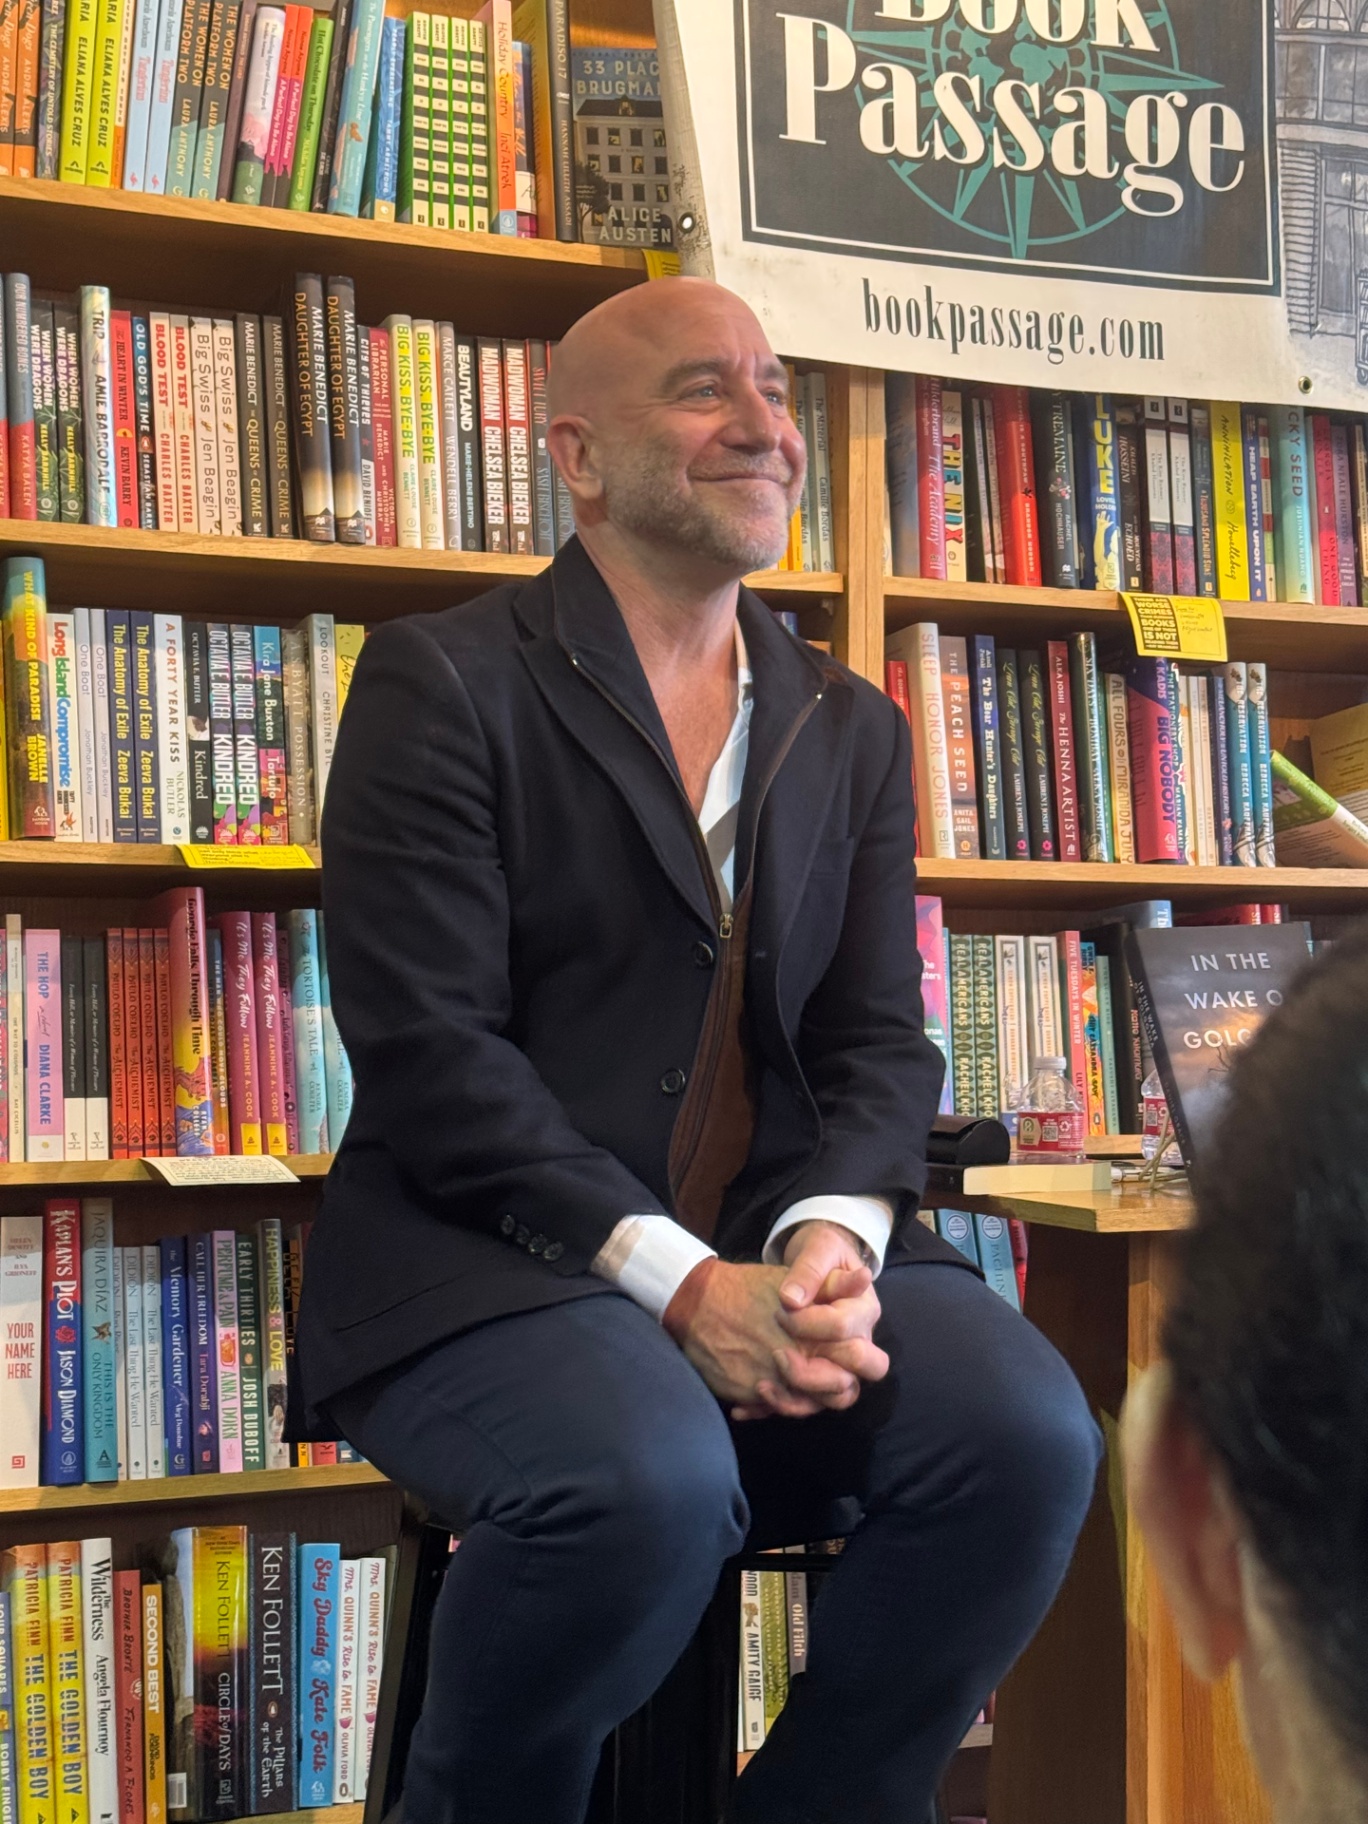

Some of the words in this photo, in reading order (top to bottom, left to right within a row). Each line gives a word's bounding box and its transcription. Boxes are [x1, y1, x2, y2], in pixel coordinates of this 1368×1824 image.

[180, 0, 195, 54] PLATFORM
[199, 2, 209, 21] THE
[103, 38, 114, 81] ELIANA
[194, 25, 208, 67] WOMEN
[497, 21, 508, 66] Holiday
[177, 59, 189, 83] TWO
[192, 70, 202, 86] ON
[311, 45, 324, 91] Chocolate
[583, 61, 605, 74] 33
[614, 62, 659, 76] PLAC
[100, 82, 111, 115] ALVES
[497, 68, 507, 119] Country
[181, 99, 192, 127] LAURA
[304, 99, 316, 133] Thursday
[775, 12, 1245, 217] Passage
[98, 118, 109, 147] CRUZ
[176, 129, 188, 177] ANTHONY
[607, 207, 662, 221] ALICE
[600, 227, 671, 243] AUSTEN
[31, 325, 41, 354] WERE
[92, 310, 105, 339] TRIP
[135, 324, 145, 350] OLD
[295, 292, 311, 369] DAUGHTER
[311, 307, 323, 351] MARIE
[397, 325, 409, 352] BIG
[862, 277, 1165, 365] bookpassage.com
[42, 330, 52, 360] WHEN
[116, 341, 125, 372] HEART
[155, 324, 166, 368] BLOOD
[195, 335, 210, 361] Big
[32, 357, 42, 410] DRAGONS
[42, 364, 53, 406] WOMEN
[95, 375, 106, 410] AMIE
[118, 375, 126, 384] IN
[137, 355, 146, 396] GOD'S
[157, 372, 168, 407] TEST
[198, 366, 211, 413] Swiss
[299, 372, 311, 389] OF
[313, 353, 327, 423] BENEDICT
[458, 345, 472, 431] BEAUTYLAND
[482, 348, 501, 421] MADWOMAN
[118, 386, 128, 420] WINTER
[139, 401, 150, 432] TIME
[300, 393, 313, 436] EGYPT
[401, 397, 415, 458] BYE-BYE
[1094, 394, 1114, 494] LUKE
[160, 433, 171, 479] CHARLES
[201, 437, 212, 462] Jen
[485, 426, 502, 482] CHELSEA
[942, 434, 961, 485] THE
[162, 482, 173, 523] BAXTER
[201, 467, 215, 519] Beagin
[487, 486, 504, 524] BIEKER
[1251, 481, 1259, 526] EARTH
[943, 493, 963, 544] NIX
[1252, 528, 1261, 564] UPON
[23, 571, 34, 605] WHAT
[1253, 566, 1262, 581] IT
[24, 607, 36, 642] KIND
[112, 624, 125, 645] The
[166, 623, 175, 632] A
[1140, 619, 1175, 628] BOOKS
[1144, 632, 1154, 640] IS
[1156, 633, 1177, 641] NOT
[27, 645, 37, 659] OF
[166, 637, 177, 683] FORTY
[210, 631, 228, 671] OCTAVIA
[262, 642, 274, 666] Kira
[111, 646, 127, 697] Anatomy
[261, 668, 275, 695] Jane
[28, 661, 40, 721] PARADISE
[117, 698, 129, 712] of
[168, 688, 178, 724] YEAR
[211, 682, 231, 719] BUTLER
[1112, 680, 1123, 703] ALL
[117, 710, 130, 740] Exile
[265, 699, 277, 741] Buxton
[950, 681, 964, 739] PEACH
[1113, 706, 1126, 749] FOURS
[169, 732, 180, 762] KISS
[1156, 717, 1170, 748] BIG
[28, 736, 38, 782] BROWN
[36, 734, 48, 783] JANELLE
[117, 750, 130, 783] Zeeva
[213, 733, 234, 804] KINDRED
[1058, 728, 1070, 782] HENNA
[262, 756, 281, 798] Tartufo
[1158, 752, 1174, 823] NOBODY
[119, 786, 132, 819] Bukai
[1061, 787, 1076, 840] ARTIST
[37, 952, 48, 972] THE
[978, 942, 986, 968] REAL
[1068, 940, 1076, 956] FIVE
[1191, 954, 1219, 971] IN
[1226, 952, 1271, 969] THE
[38, 976, 49, 998] HOP
[1070, 959, 1078, 999] TUESDAYS
[979, 971, 990, 1026] AMERICANS
[1072, 1002, 1078, 1012] IN
[1185, 990, 1257, 1009] WAKE
[1072, 1014, 1081, 1045] WINTER
[39, 1045, 51, 1078] DIANA
[39, 1082, 51, 1124] CLARKE
[239, 1243, 252, 1280] EARLY
[265, 1228, 282, 1313] HAPPINESS
[7, 1323, 33, 1339] YOUR
[240, 1289, 255, 1345] THIRTIES
[270, 1315, 281, 1328] &
[5, 1343, 35, 1358] NAME
[268, 1331, 284, 1371] LOVE
[7, 1363, 32, 1379] HERE
[243, 1377, 257, 1414] JOSH
[58, 1390, 74, 1443] DIAMOND
[244, 1415, 258, 1463] DUBOFF
[216, 1560, 230, 1591] KEN
[262, 1546, 282, 1591] KEN
[313, 1558, 333, 1592] Sky
[90, 1558, 111, 1641] Wilderness
[147, 1595, 159, 1668] SECOND
[218, 1594, 230, 1657] FOLLETT
[314, 1600, 332, 1657] Daddy
[59, 1650, 78, 1681] THE
[262, 1600, 284, 1694] FOLLETT
[747, 1633, 760, 1666] AMITY
[93, 1654, 108, 1697] Angela
[147, 1669, 160, 1714] BEST
[308, 1678, 332, 1723] Kate
[60, 1686, 81, 1754] GOLDEN
[95, 1698, 111, 1756] Flournoy
[312, 1730, 328, 1774] Folk
[63, 1762, 82, 1795] BOY
